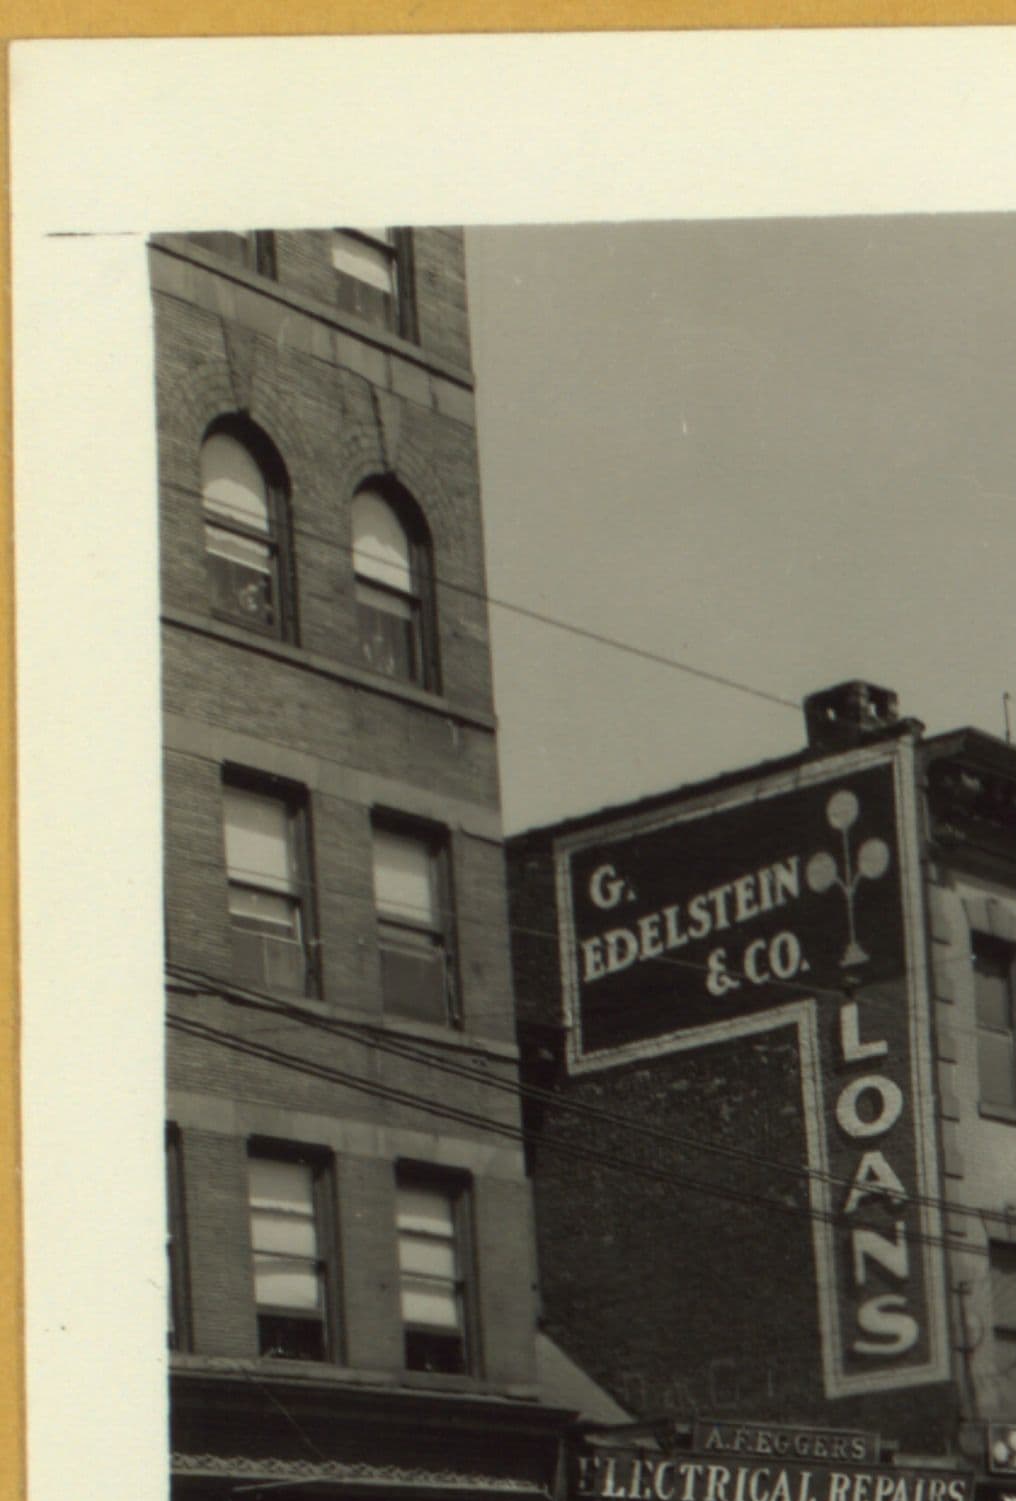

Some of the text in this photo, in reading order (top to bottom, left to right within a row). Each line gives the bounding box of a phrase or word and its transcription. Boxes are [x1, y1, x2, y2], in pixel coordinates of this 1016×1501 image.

[581, 857, 801, 982] EDELSTEIN
[590, 864, 636, 909] G.
[705, 931, 811, 996] & CO.
[836, 1002, 920, 1355] LOANS
